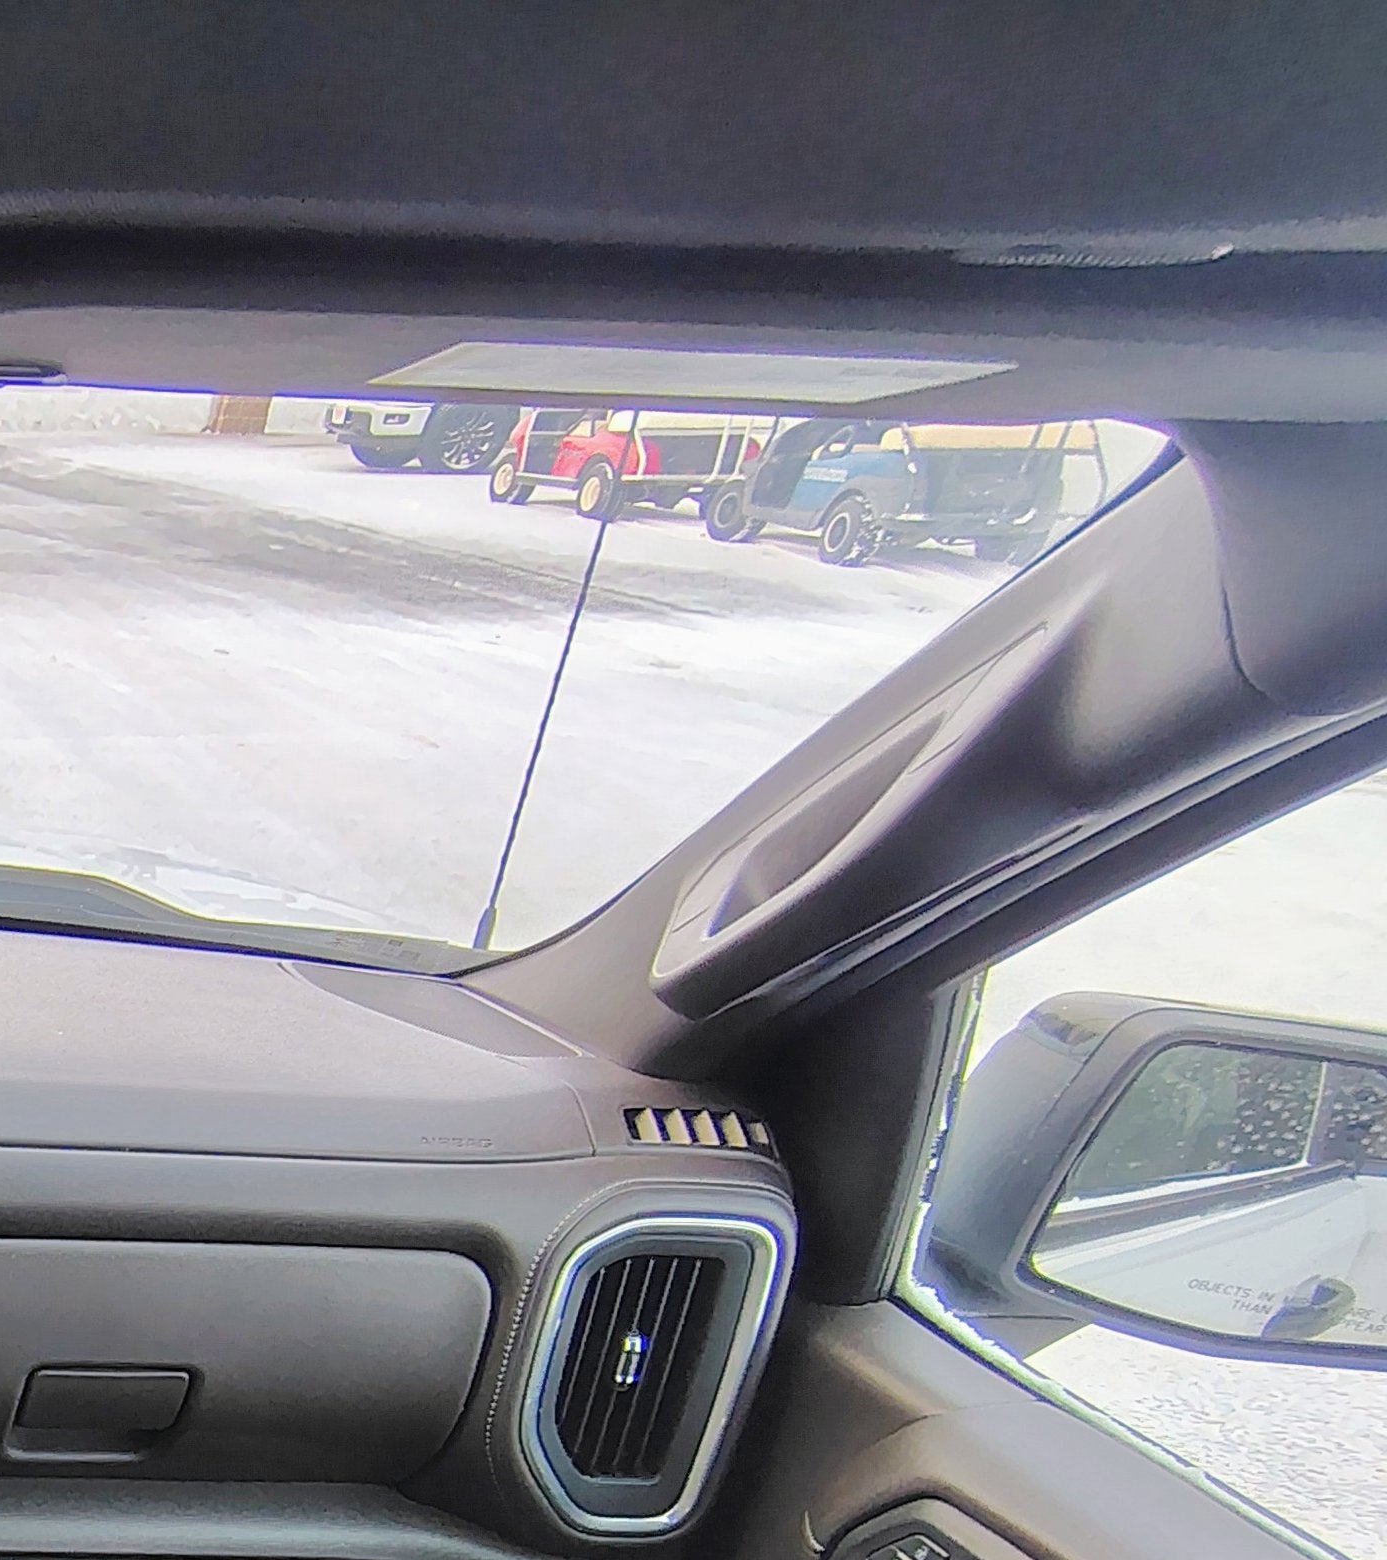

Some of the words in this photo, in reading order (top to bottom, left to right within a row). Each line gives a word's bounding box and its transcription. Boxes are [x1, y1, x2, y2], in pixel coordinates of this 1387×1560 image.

[1188, 1278, 1251, 1298] OBJECTS
[1257, 1290, 1276, 1302] IN
[1231, 1300, 1274, 1315] THAN
